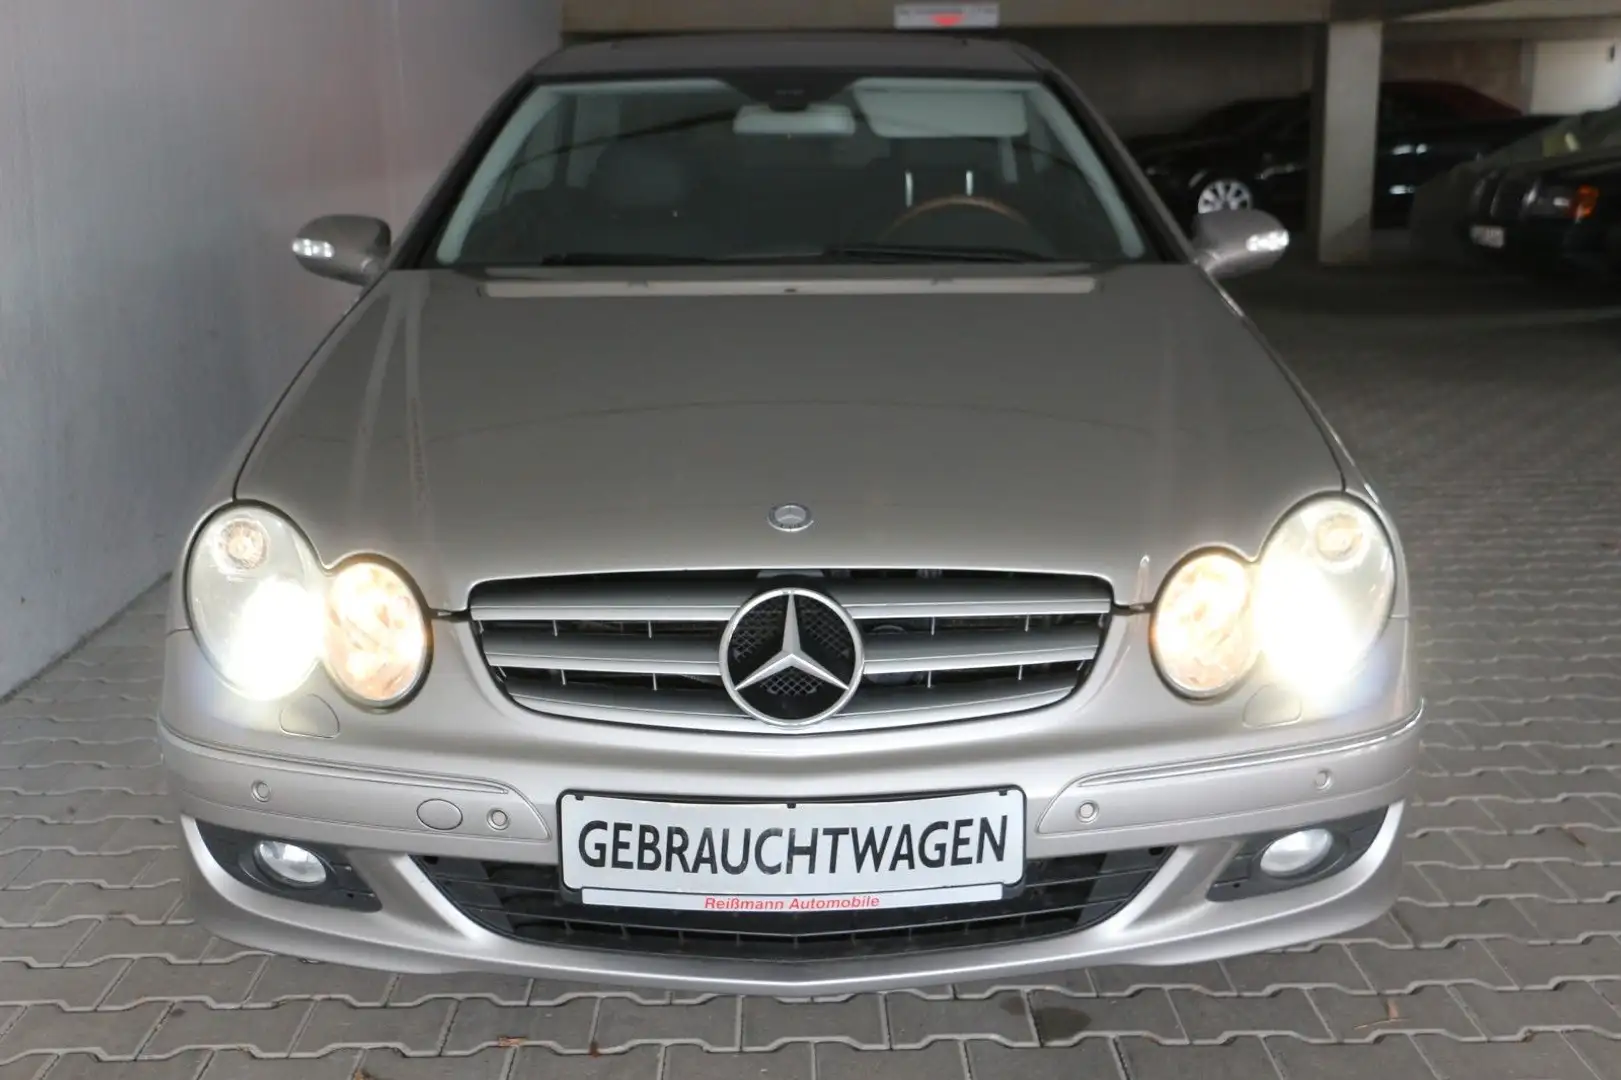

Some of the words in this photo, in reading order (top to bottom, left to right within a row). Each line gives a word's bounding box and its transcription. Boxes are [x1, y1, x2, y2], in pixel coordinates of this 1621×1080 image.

[578, 815, 1007, 875] GEBRAUCHTWAGEN
[704, 896, 785, 911] Reißmann
[788, 895, 880, 911] Automobile
